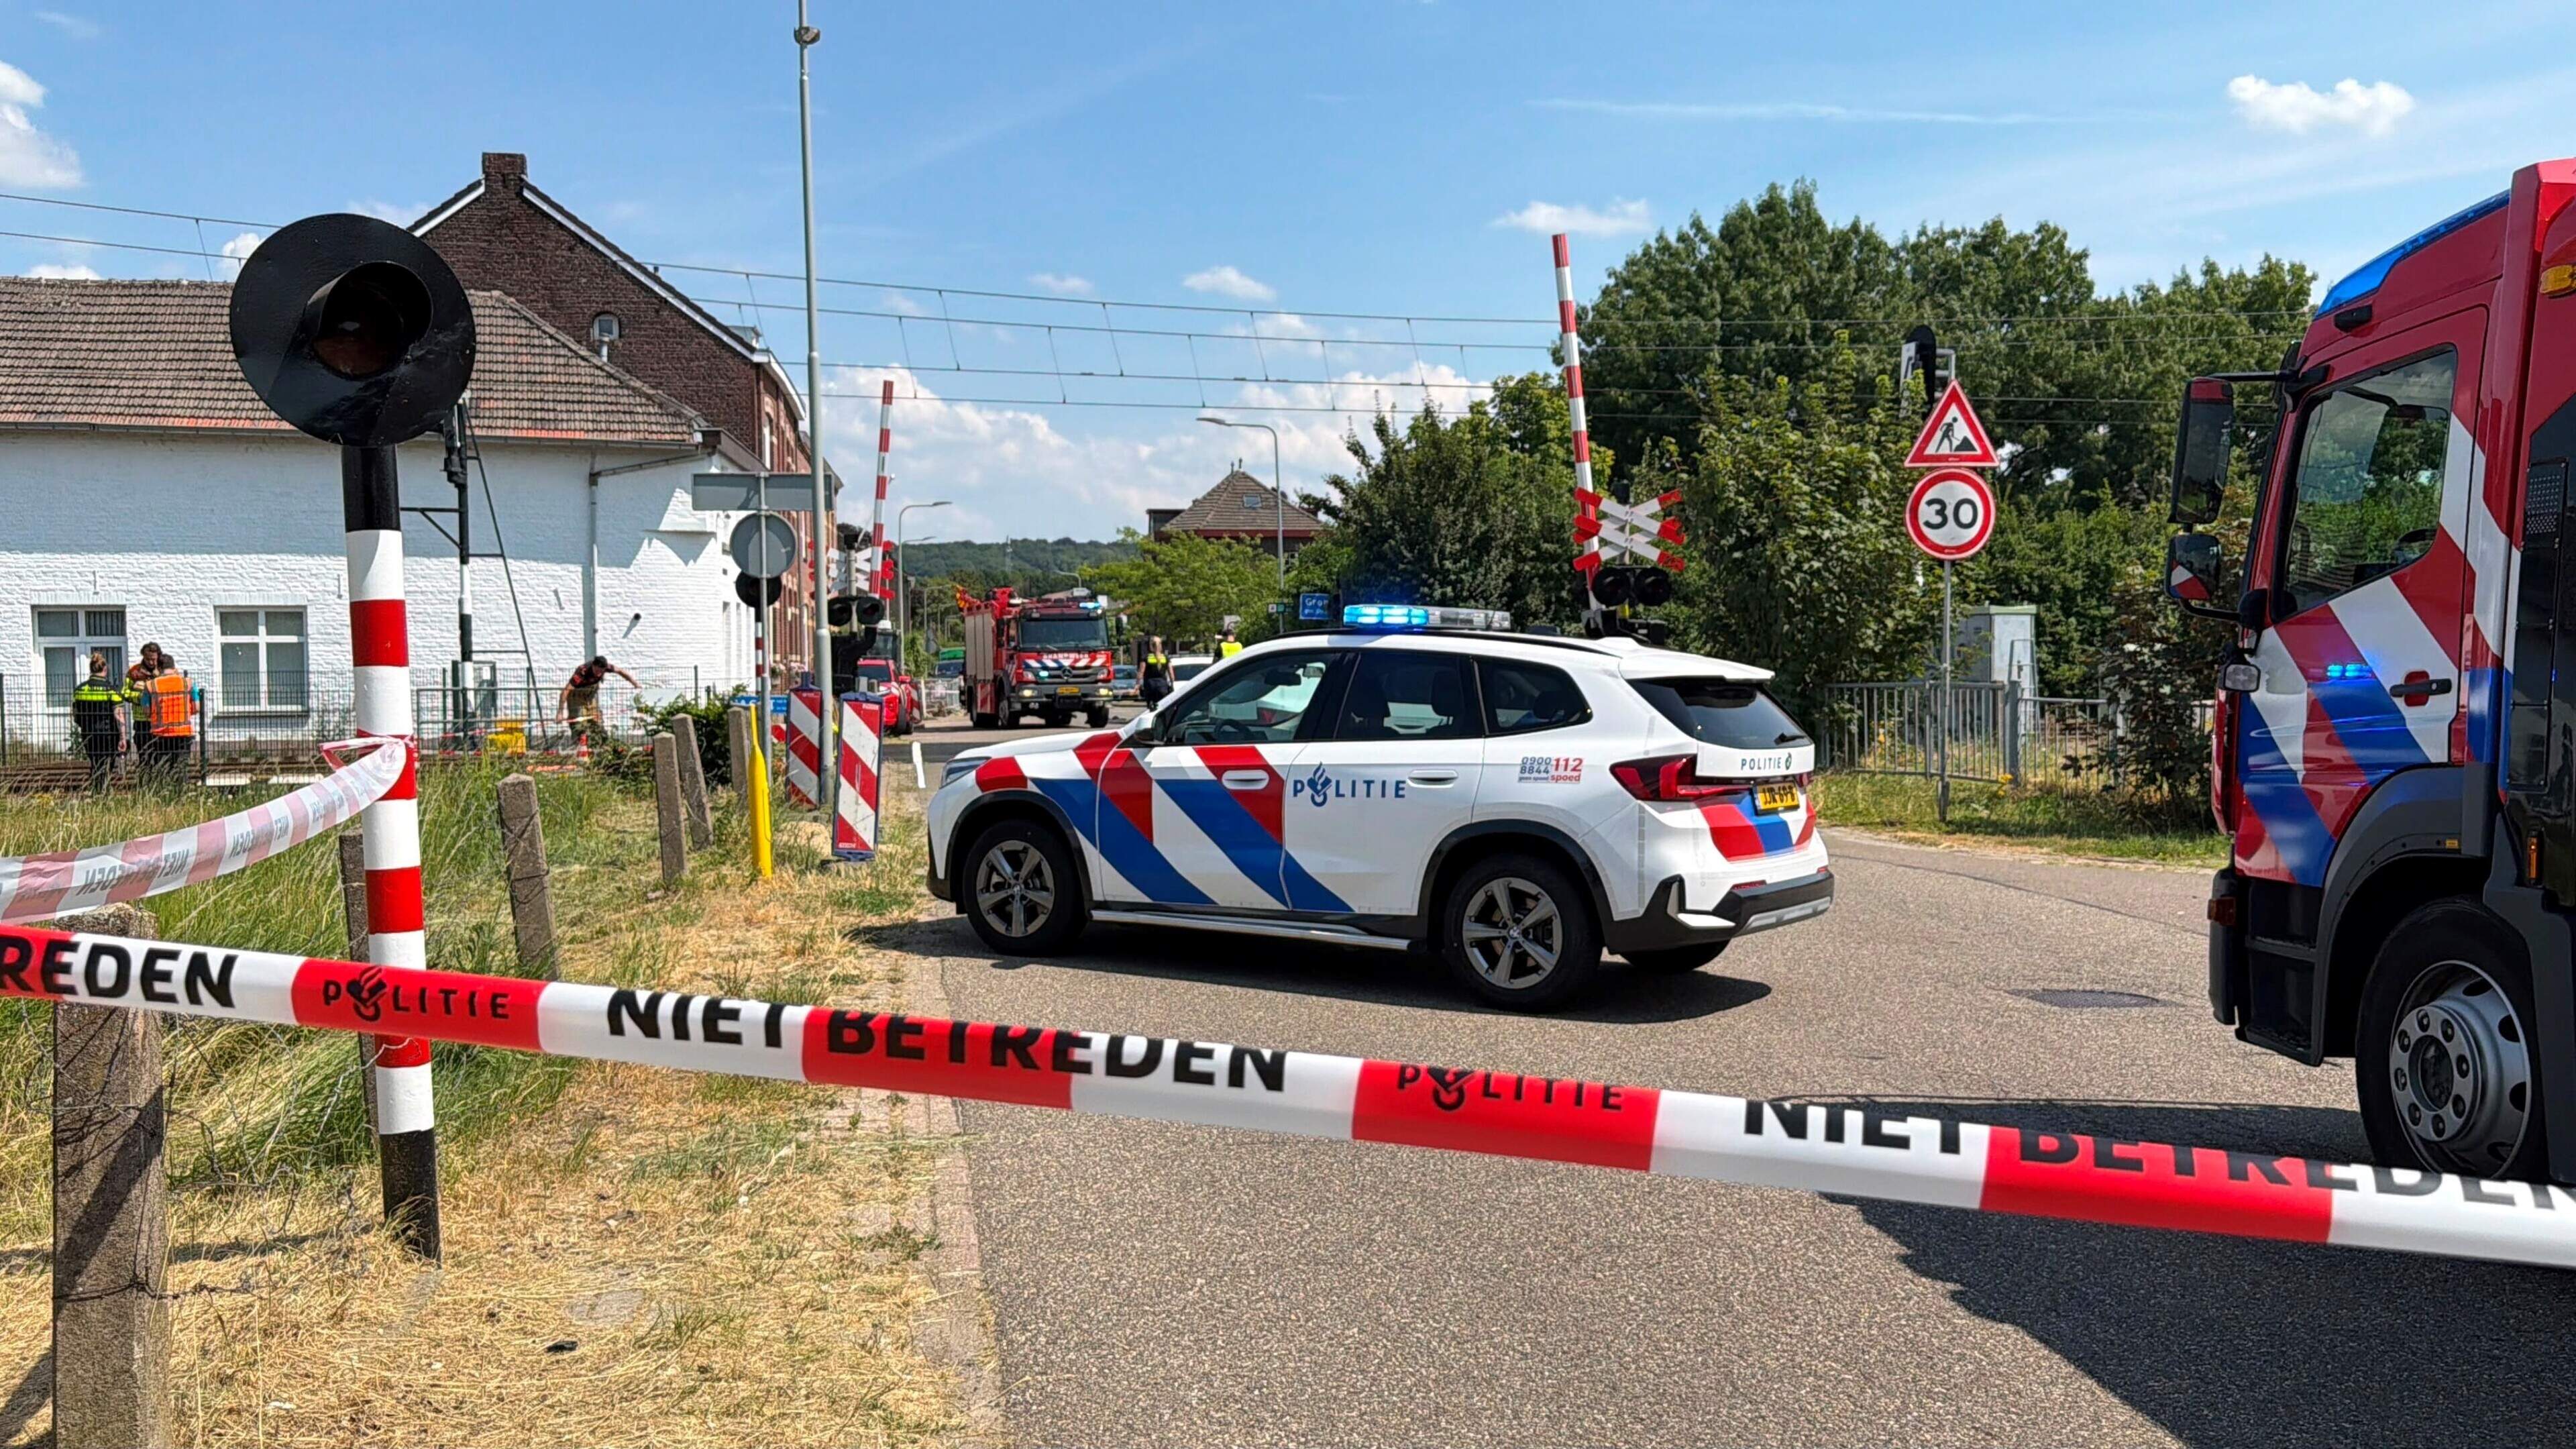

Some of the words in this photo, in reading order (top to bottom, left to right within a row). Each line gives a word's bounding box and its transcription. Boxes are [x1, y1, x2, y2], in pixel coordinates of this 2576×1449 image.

[1923, 498, 1978, 530] 30
[1521, 756, 1552, 765] 0900
[1554, 757, 1584, 771] 112
[1741, 757, 1782, 771] POLITIE
[1519, 765, 1550, 774] 8844
[1550, 773, 1581, 783] spoed
[607, 989, 784, 1049] NIET
[828, 1009, 1287, 1092] BETREDEN
[1744, 1101, 1961, 1155] NIET
